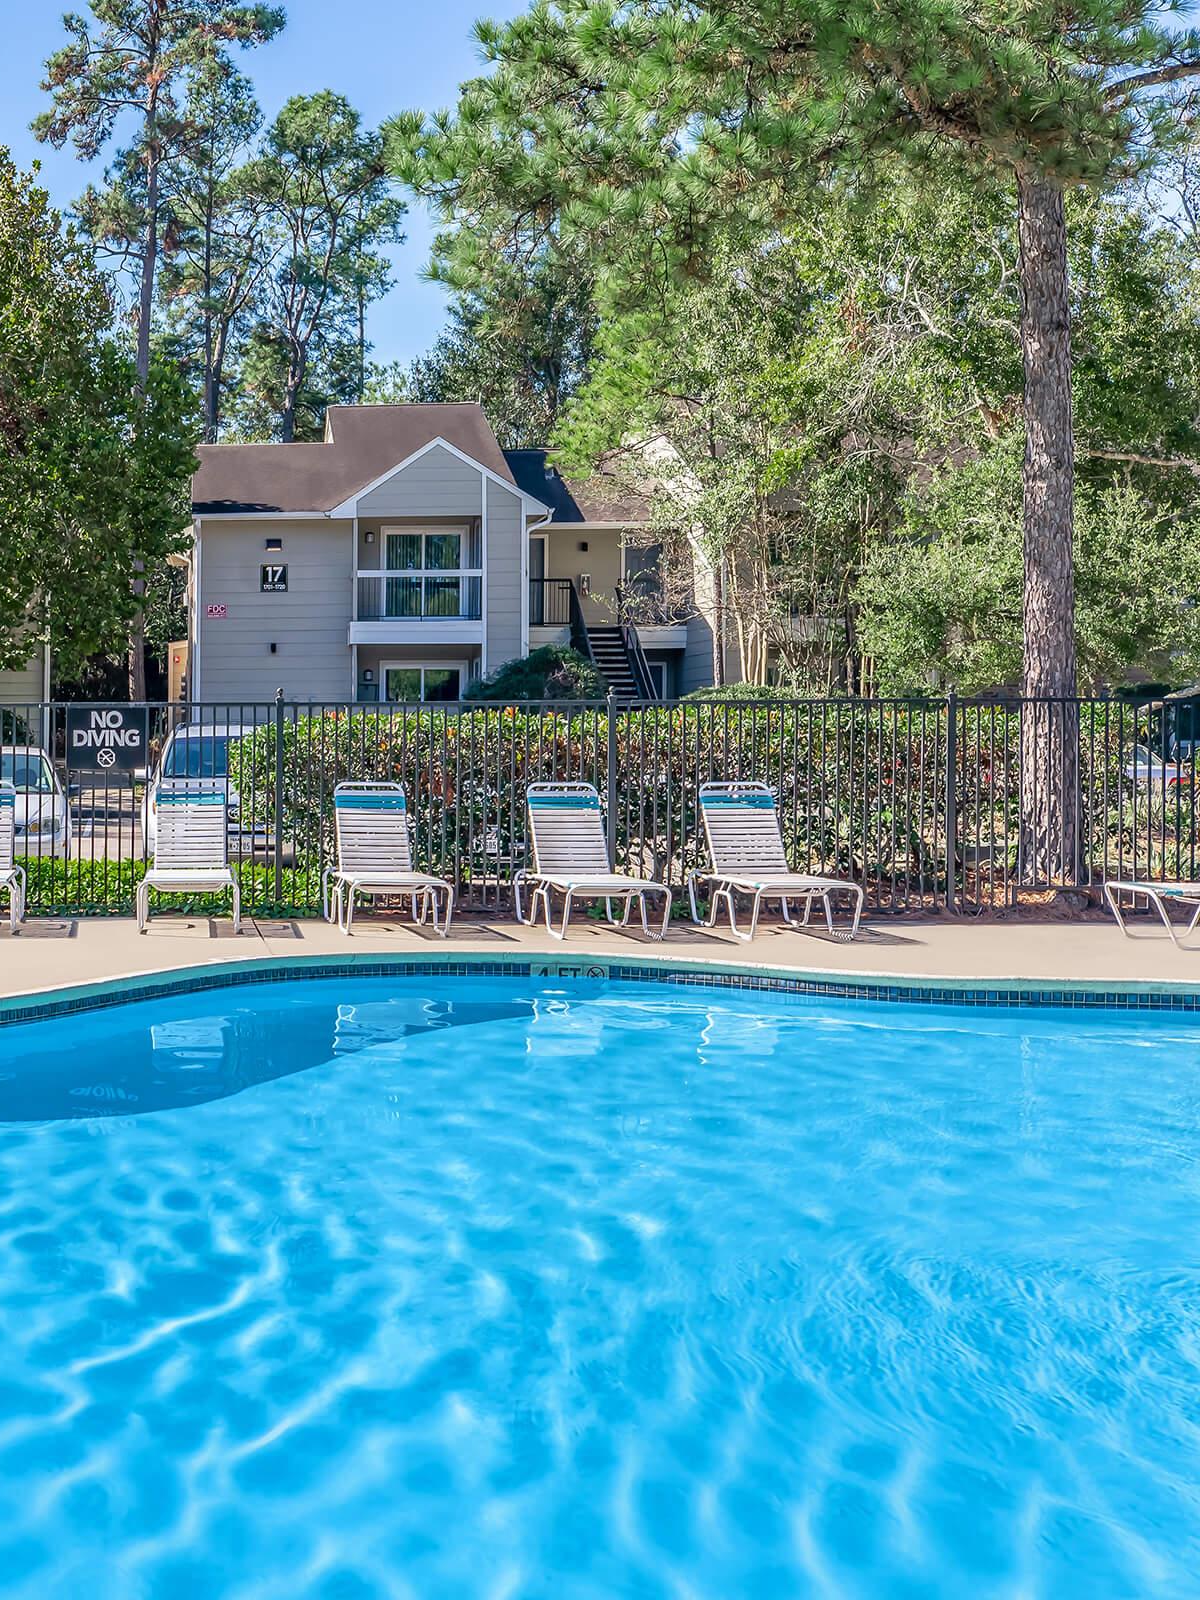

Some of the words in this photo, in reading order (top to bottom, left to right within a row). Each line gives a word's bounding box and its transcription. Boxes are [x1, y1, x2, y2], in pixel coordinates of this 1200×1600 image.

[266, 566, 283, 582] 17
[90, 710, 123, 728] NO
[73, 730, 140, 747] DIVING
